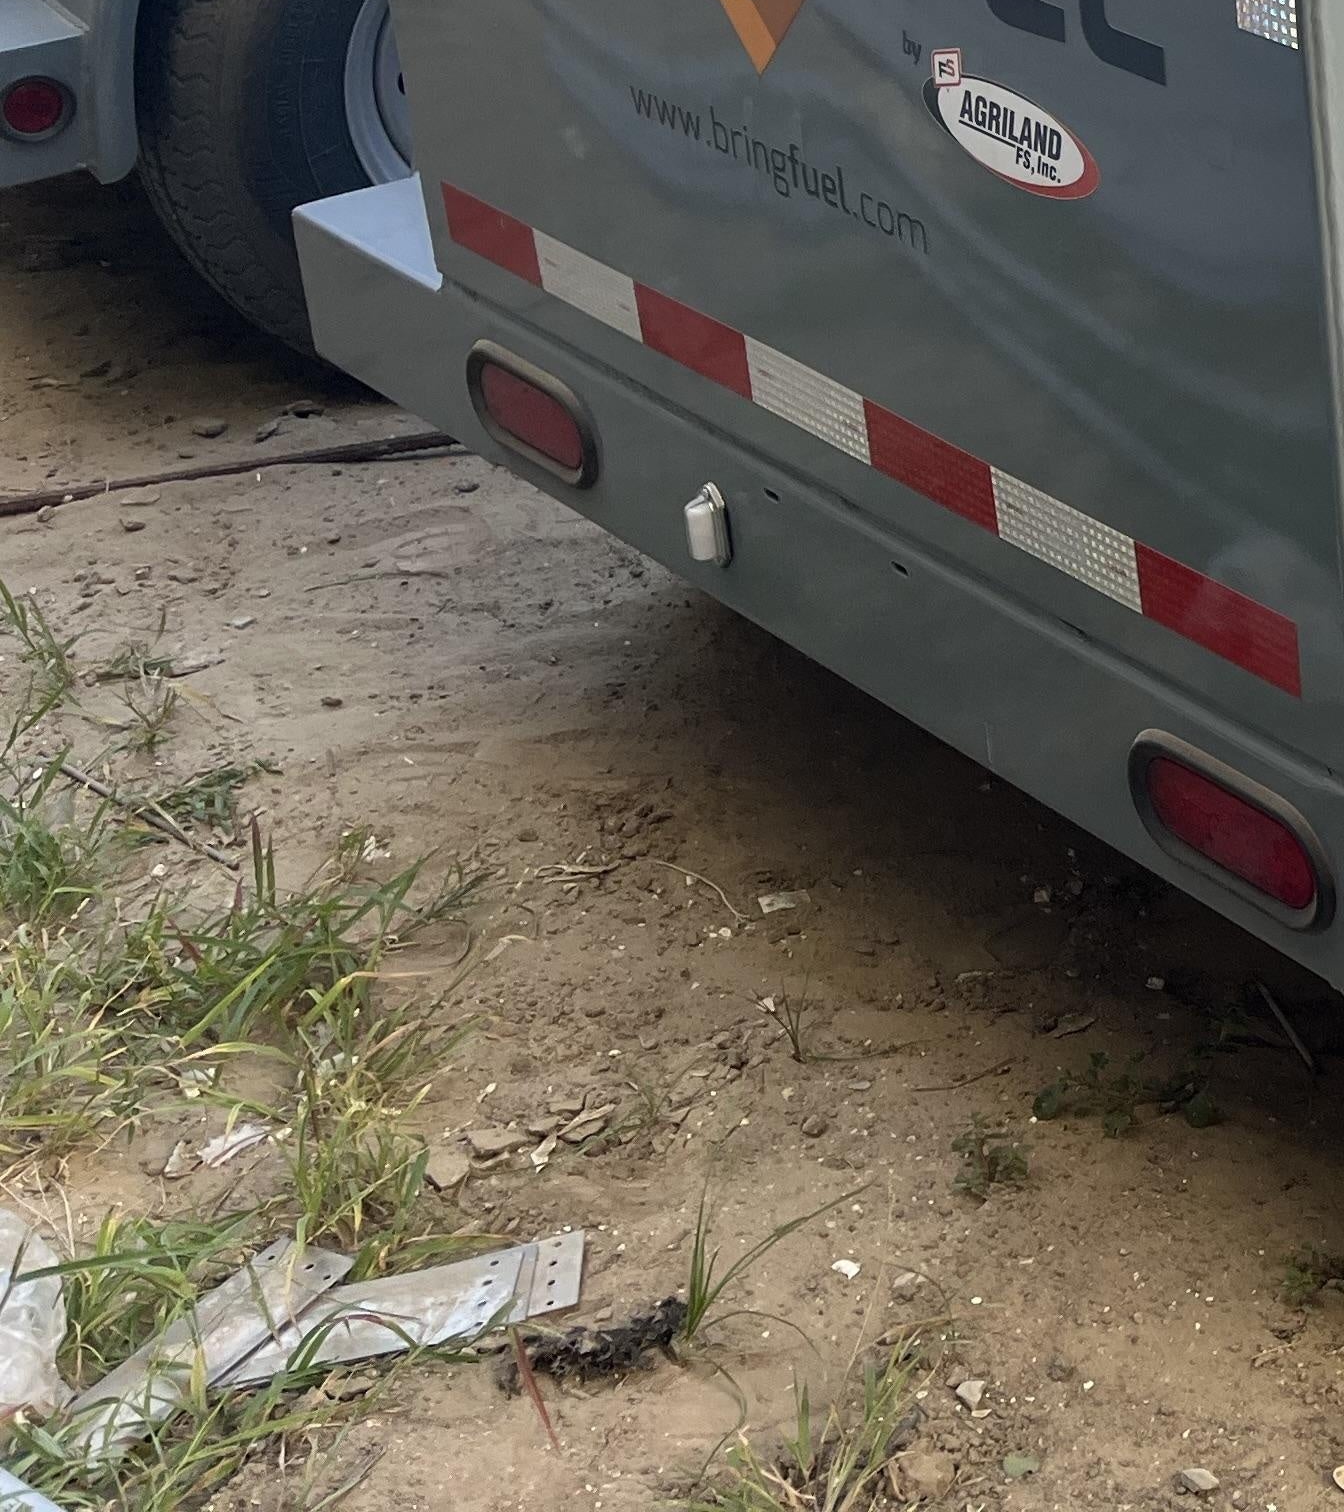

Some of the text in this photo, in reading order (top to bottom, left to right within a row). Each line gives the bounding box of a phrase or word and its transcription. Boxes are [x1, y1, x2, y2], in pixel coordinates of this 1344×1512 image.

[902, 29, 922, 65] by
[959, 89, 1063, 161] AGRILAND
[629, 85, 929, 256] www.bringfuel.com
[1036, 157, 1062, 184] Inc.
